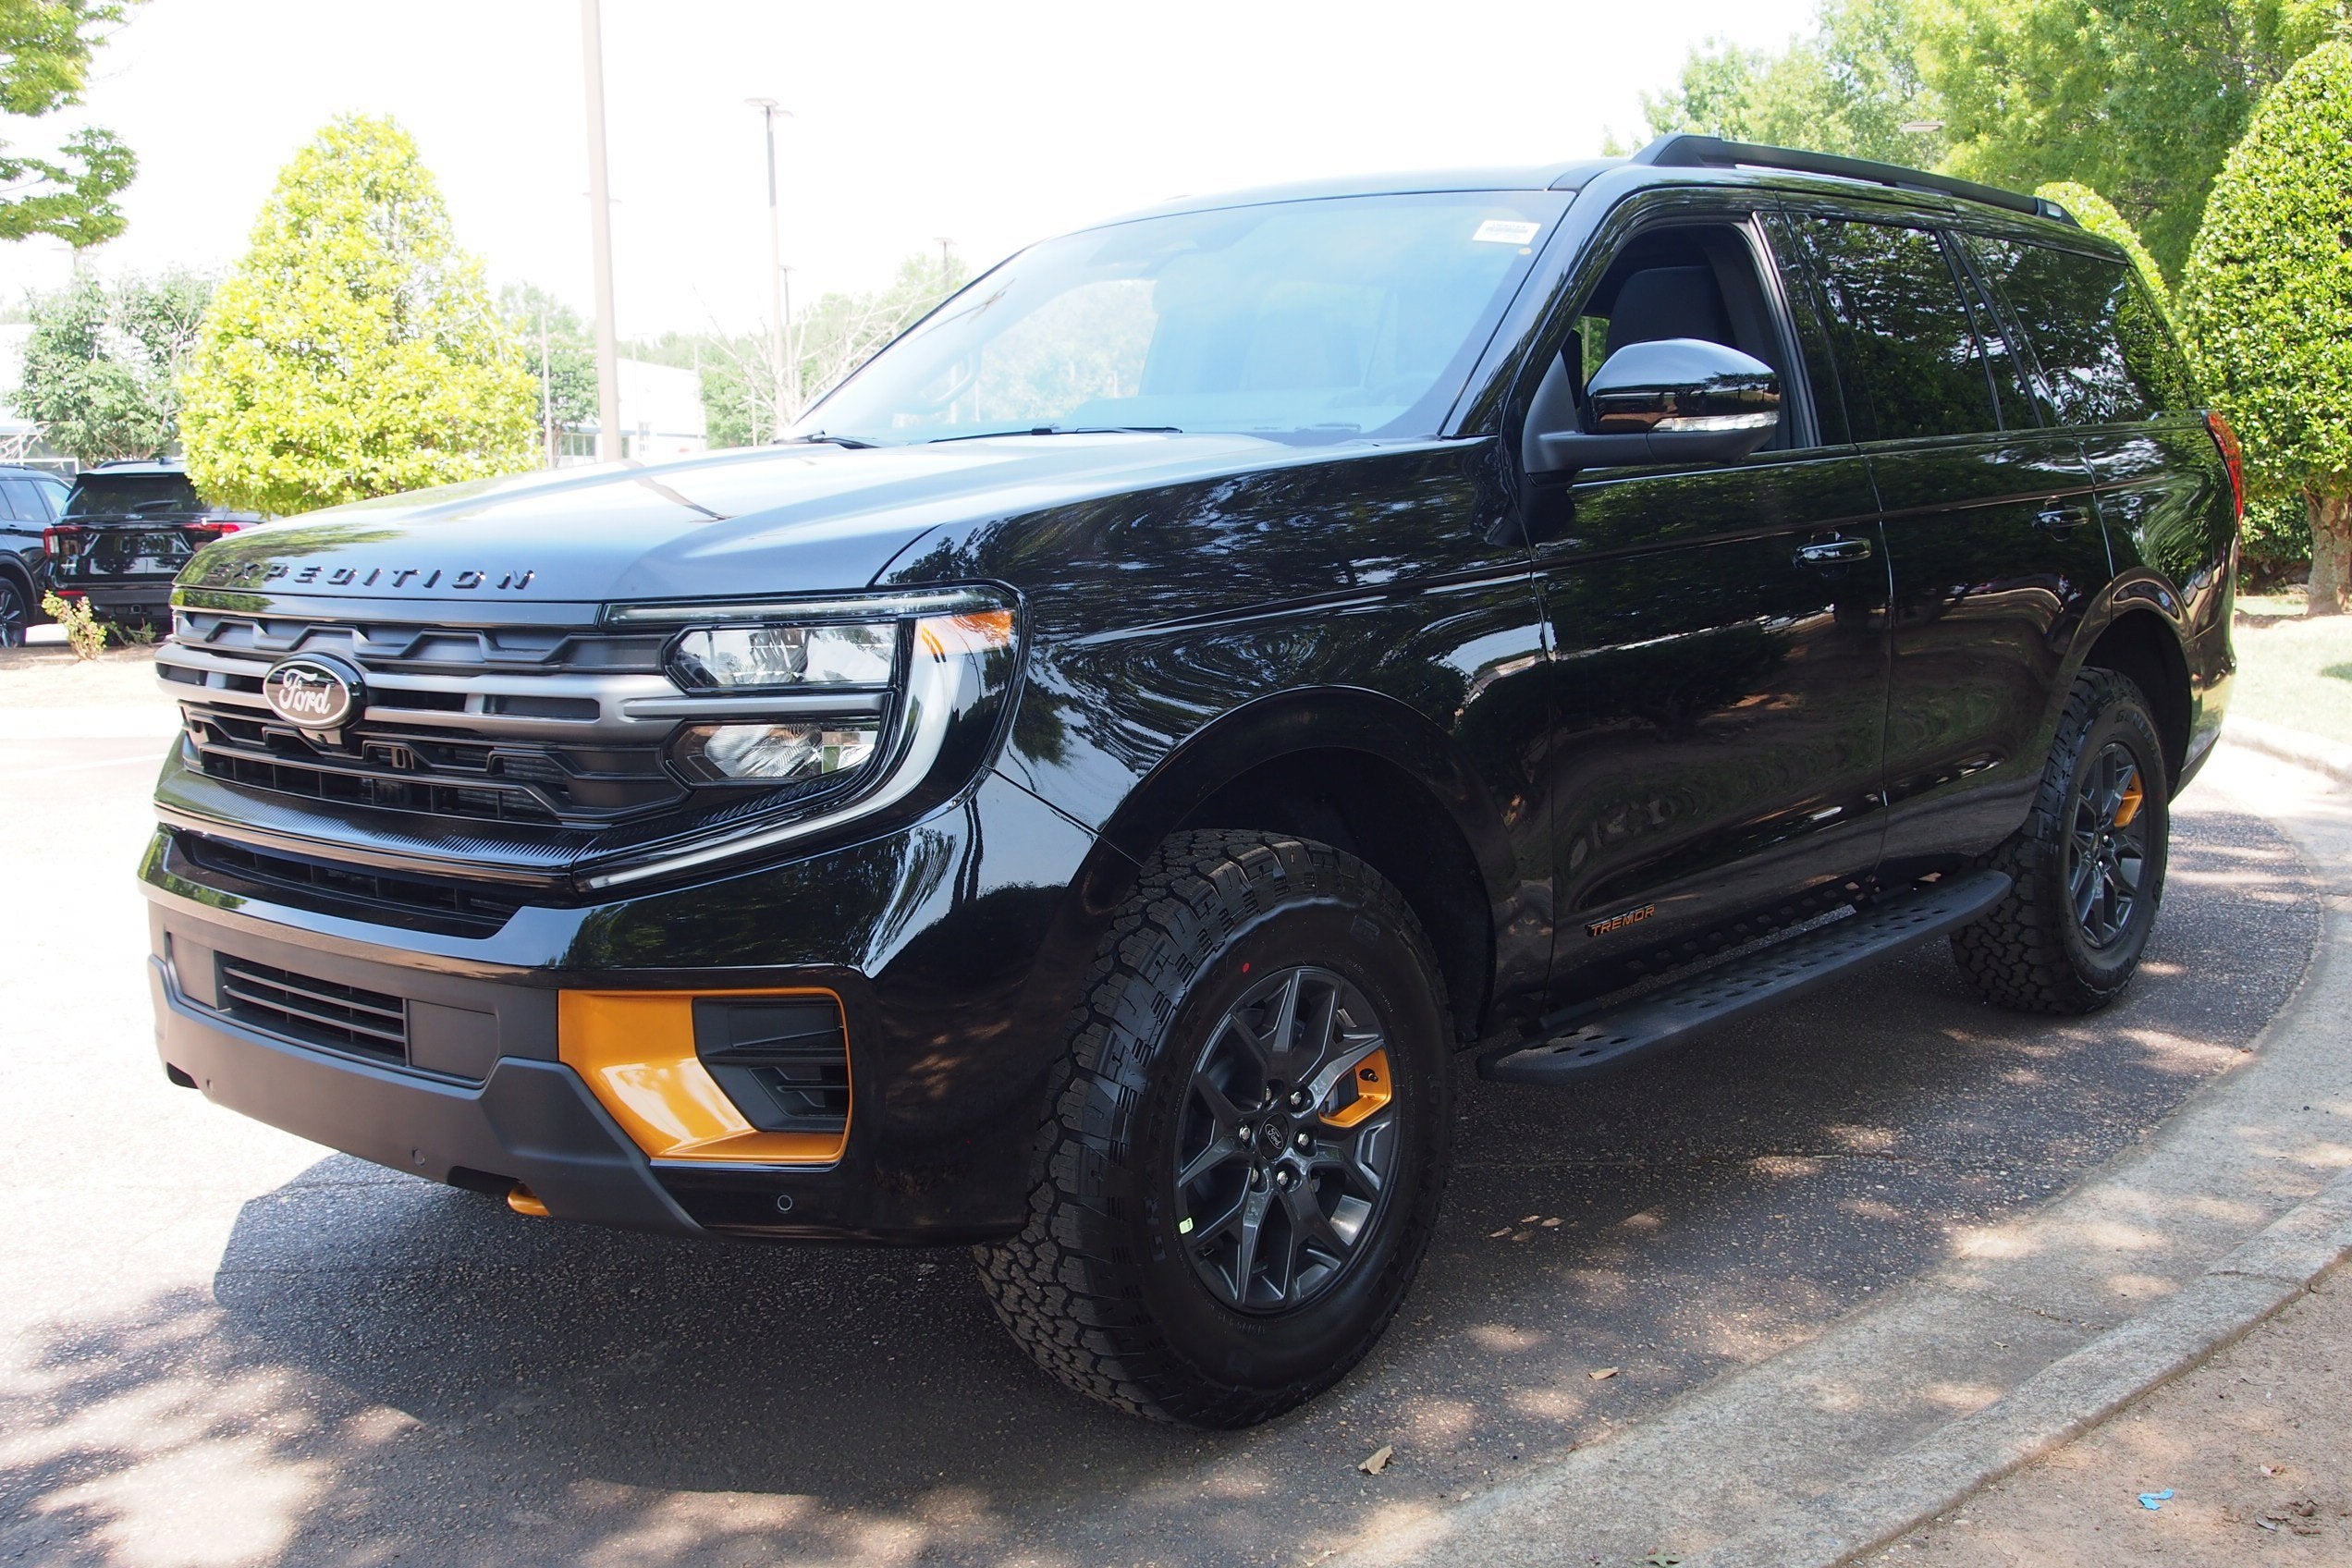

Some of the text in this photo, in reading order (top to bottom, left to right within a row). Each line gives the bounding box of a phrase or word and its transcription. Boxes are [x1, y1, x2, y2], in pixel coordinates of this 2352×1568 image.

[208, 561, 536, 592] EXPEDITION
[278, 668, 332, 716] Ford
[1589, 903, 1656, 937] TREMOR
